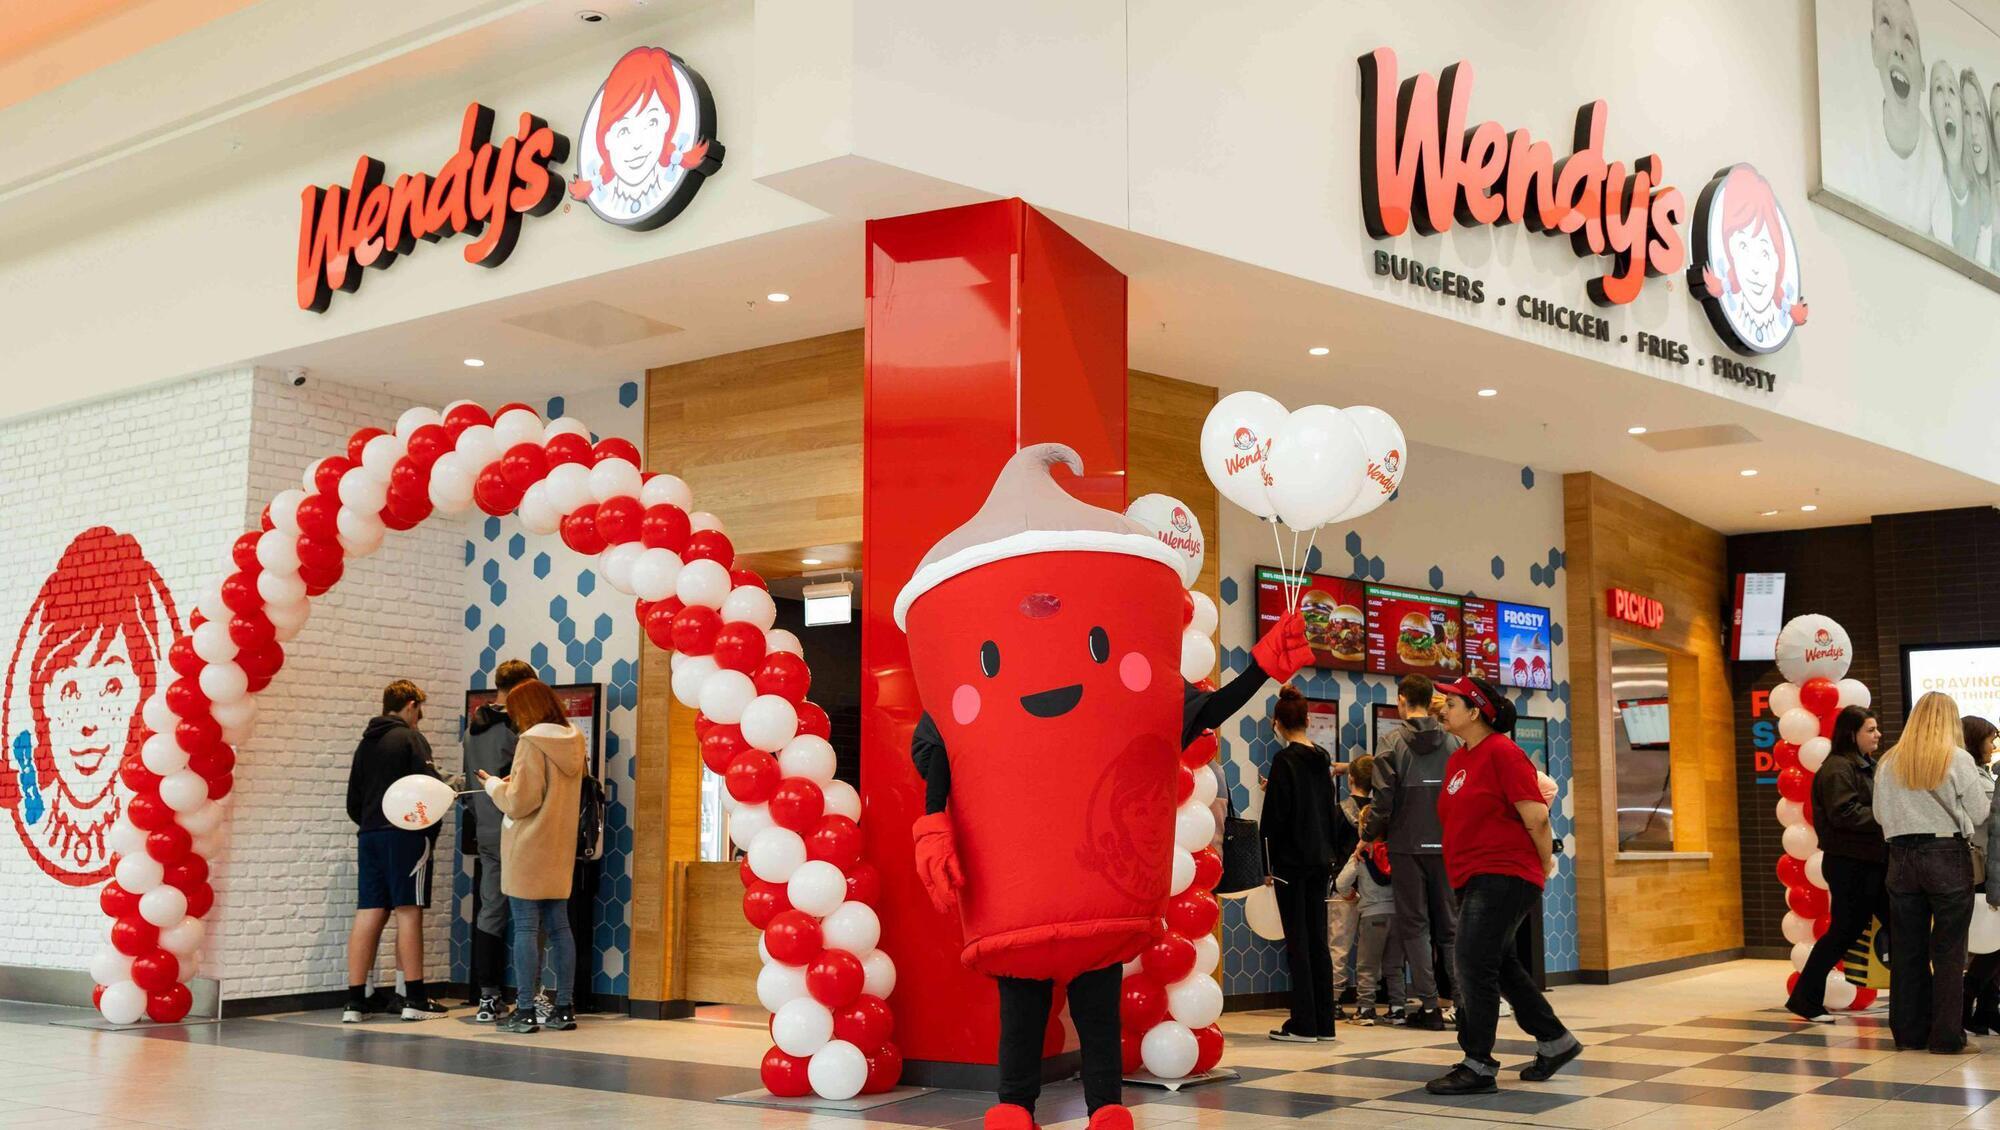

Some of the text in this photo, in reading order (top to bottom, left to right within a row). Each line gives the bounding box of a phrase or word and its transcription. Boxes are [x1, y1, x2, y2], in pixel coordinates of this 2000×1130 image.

[297, 102, 565, 312] Wendy's
[1360, 46, 1686, 306] Wendy's
[1374, 249, 1776, 394] BURGERS CHICKEN FRIES FROSTY
[1225, 444, 1262, 476] Wend
[1504, 609, 1544, 627] FROSTY
[1805, 646, 1845, 663] Wendy's
